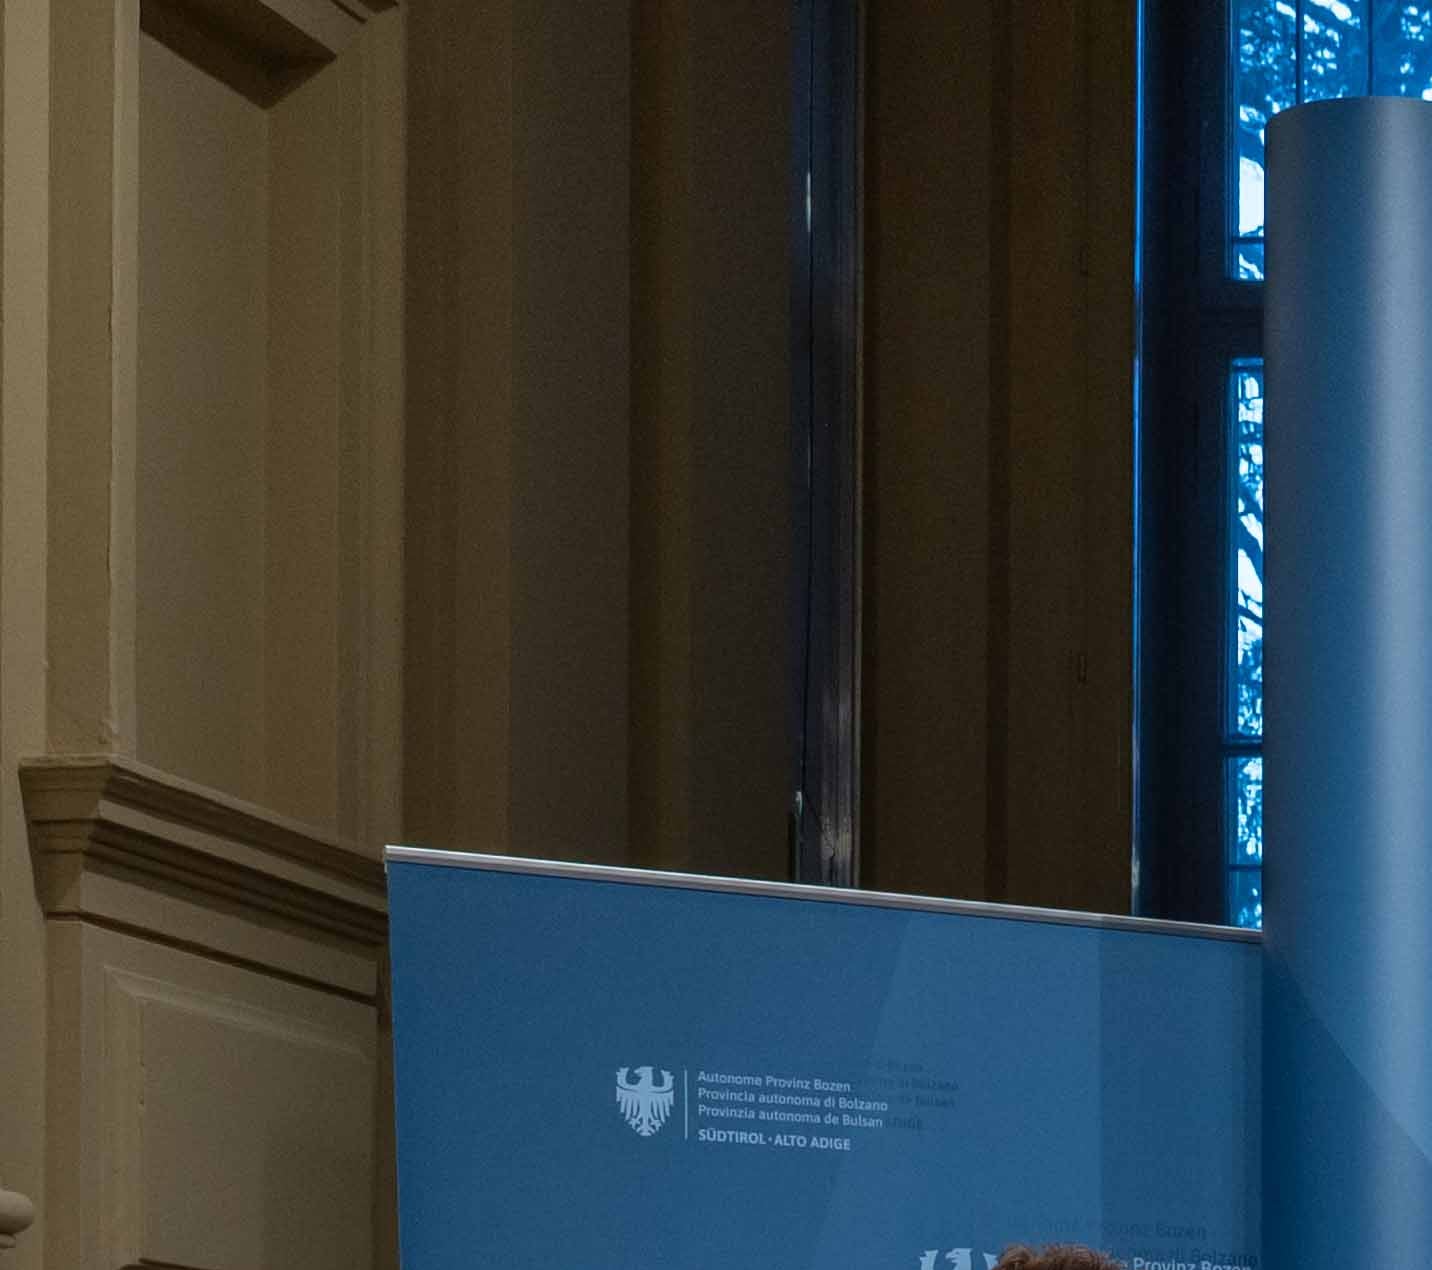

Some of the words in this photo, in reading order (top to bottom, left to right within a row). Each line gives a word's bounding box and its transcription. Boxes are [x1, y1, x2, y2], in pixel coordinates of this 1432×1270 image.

[698, 1071, 762, 1086] Autonome
[766, 1076, 810, 1090] Provinz
[814, 1079, 850, 1092] Bozen
[698, 1087, 755, 1102] Provincia
[759, 1094, 820, 1107] autonoma
[824, 1097, 835, 1108] di
[839, 1097, 888, 1111] Bolzano
[699, 1105, 755, 1119] Provinzia
[759, 1111, 820, 1123] autonoma
[824, 1113, 839, 1124] de
[843, 1114, 882, 1127] Bulsan
[699, 1128, 766, 1144] SÜDTIROL
[775, 1134, 807, 1147] ALTO
[811, 1137, 850, 1151] ADIGE
